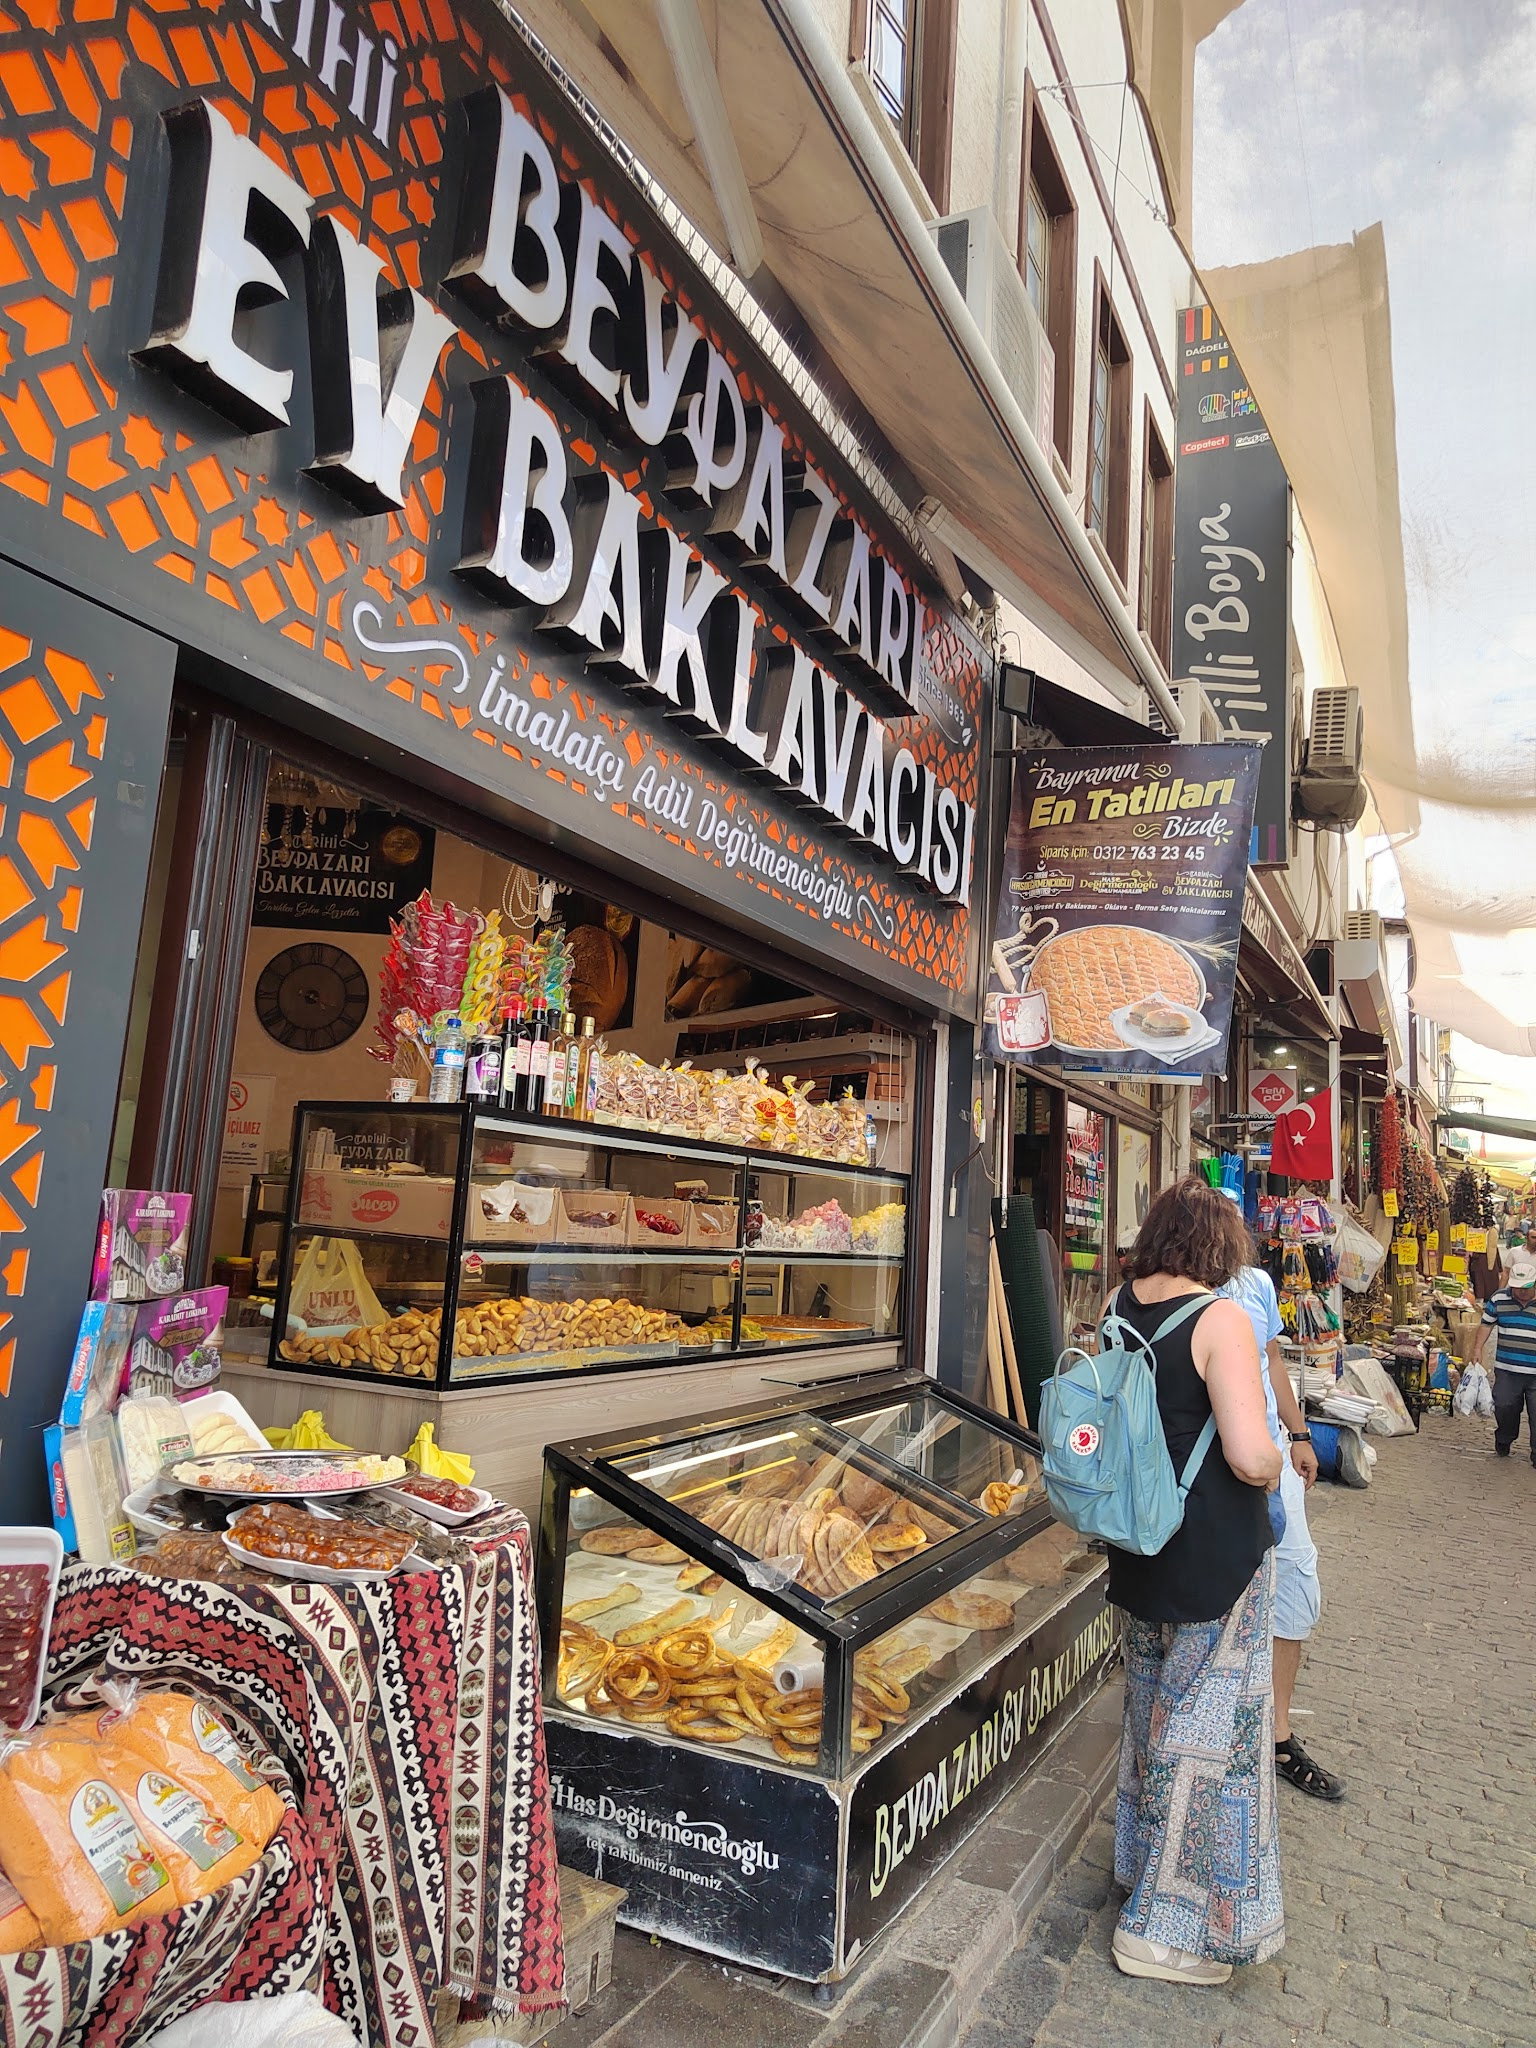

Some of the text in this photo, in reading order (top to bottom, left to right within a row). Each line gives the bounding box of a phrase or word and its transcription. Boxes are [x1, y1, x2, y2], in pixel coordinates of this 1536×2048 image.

[180, 96, 459, 509] EV
[480, 84, 926, 708] BEYPAZARI
[1185, 437, 1226, 451] Capatect
[1184, 502, 1266, 643] Boya
[486, 375, 976, 909] BAKLAVACISI
[945, 694, 965, 727] 1963
[479, 654, 854, 920] İmalatçı Adil Değirmencioğlu
[1035, 762, 1141, 795] Bayramın
[1029, 778, 1236, 829] En Tatlıları
[292, 833, 338, 849] TRİHİ
[1162, 812, 1228, 840] Bizde
[1039, 845, 1070, 861] Sipariş
[1093, 845, 1126, 860] 0312
[1130, 845, 1157, 860] 763
[1160, 845, 1181, 860] 23
[1184, 845, 1206, 860] 45
[259, 871, 396, 900] BAKLAVACISI
[1174, 876, 1223, 889] BEYPAZARI
[1175, 887, 1234, 899] BAKLAVACISI
[227, 1117, 262, 1138] İÇİLMEZ
[353, 1132, 387, 1146] TARİHİ
[54, 1476, 65, 1504] tekin
[870, 1708, 1000, 1901] BEYPAZARI
[1027, 1604, 1115, 1736] BAKLAVACISI
[554, 1780, 781, 1877] Has Değirmencioğlu
[607, 1843, 668, 1874] rakibimiz
[668, 1865, 723, 1893] anneniz
